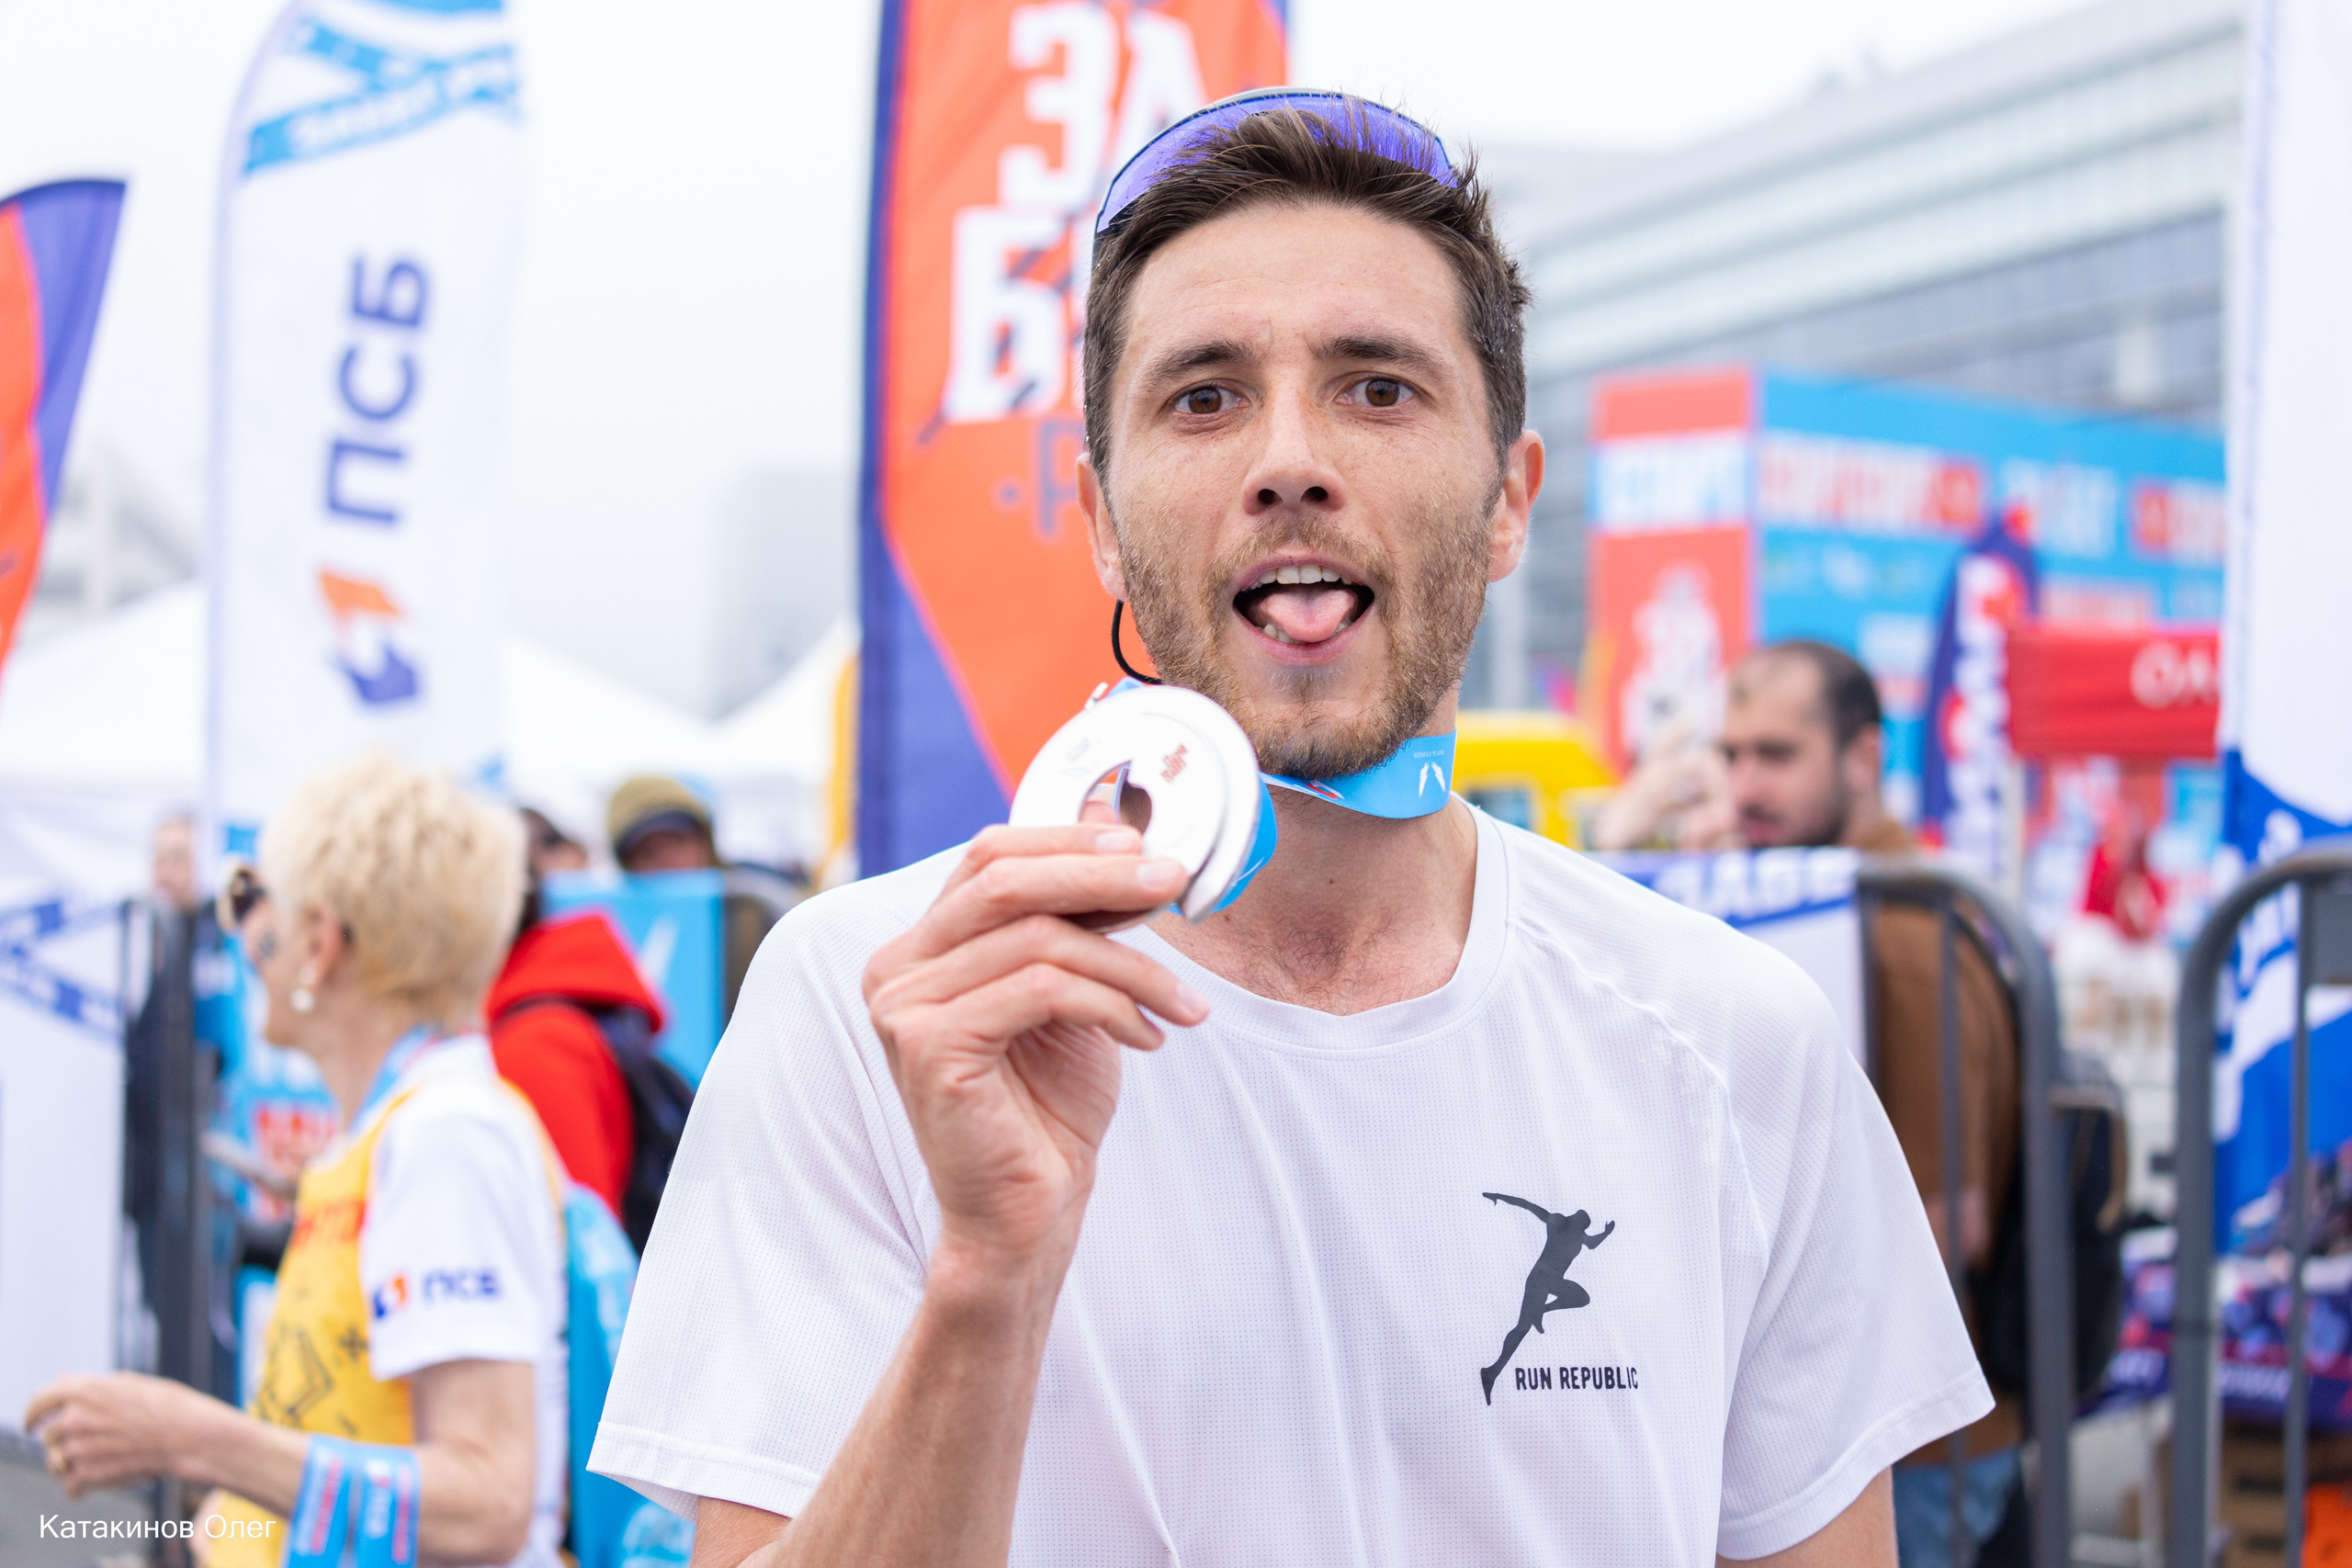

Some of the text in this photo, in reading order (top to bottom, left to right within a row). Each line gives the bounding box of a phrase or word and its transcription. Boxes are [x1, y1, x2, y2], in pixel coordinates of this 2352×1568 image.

[323, 255, 431, 527] ПСБ
[941, 206, 1093, 426] Б
[1515, 1366, 1639, 1391] RUN REPUBLIC
